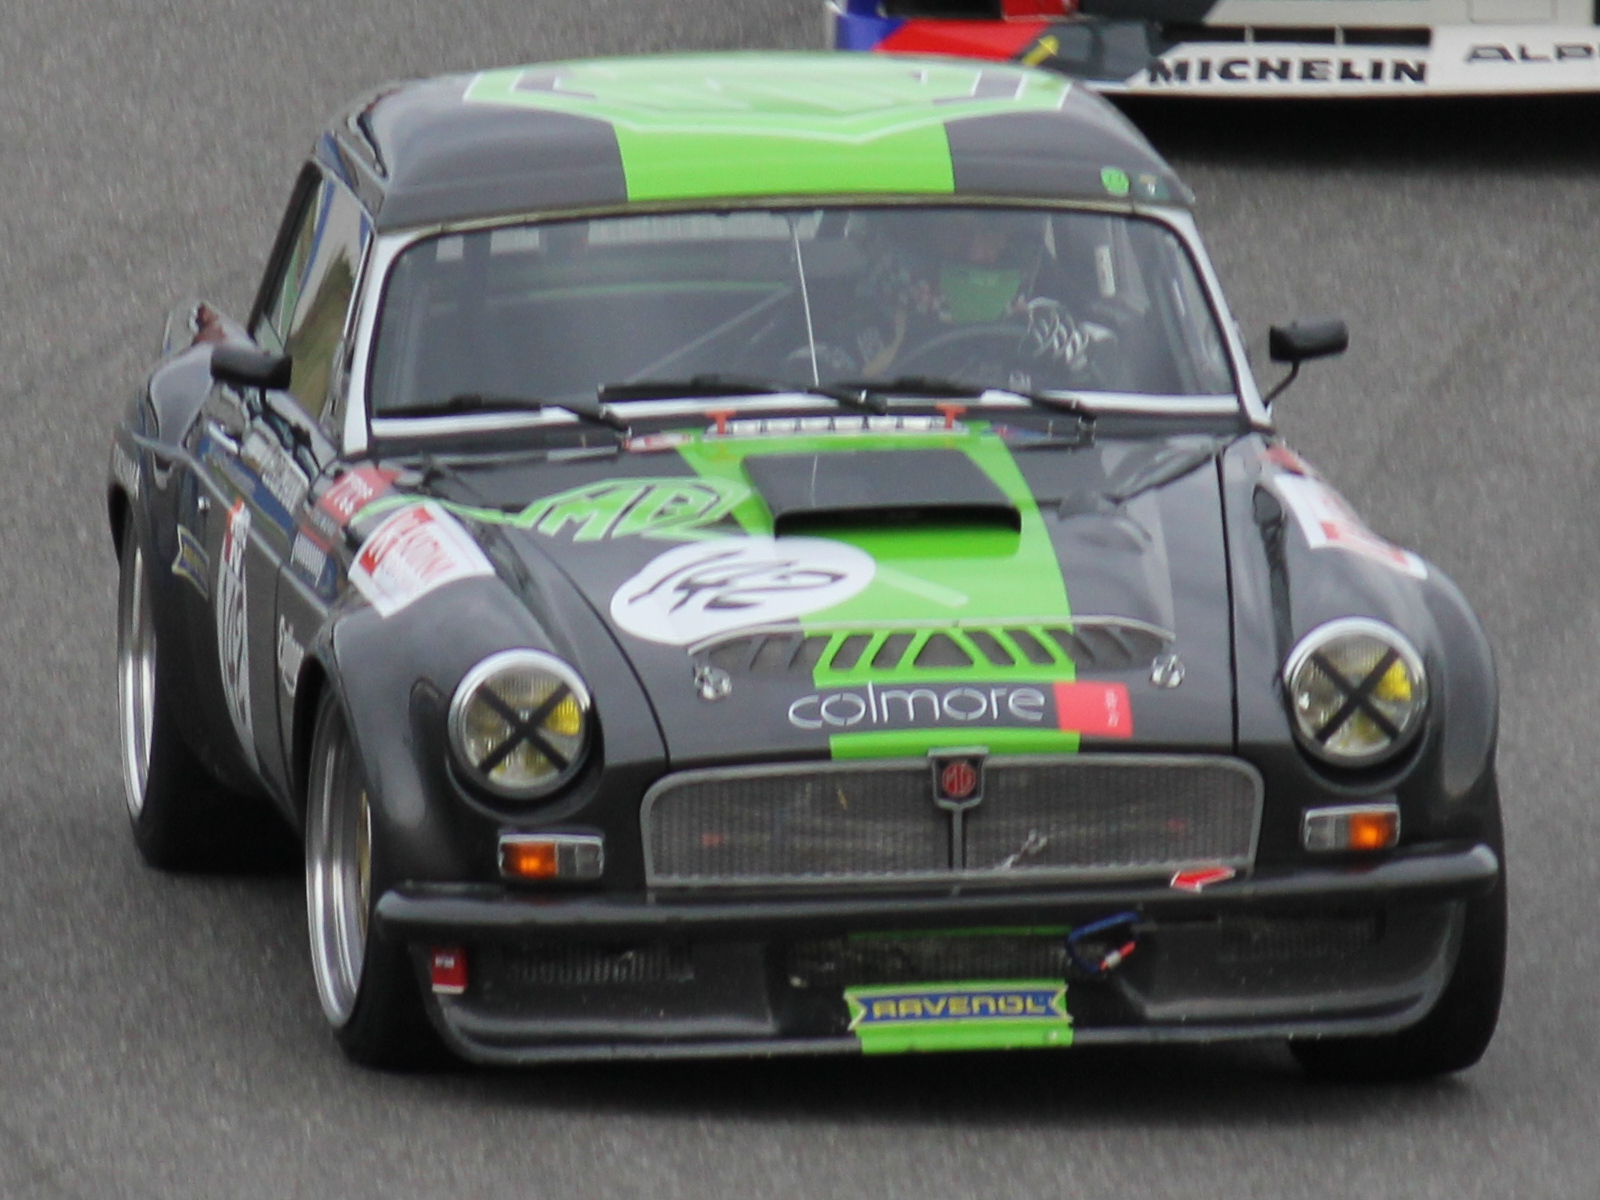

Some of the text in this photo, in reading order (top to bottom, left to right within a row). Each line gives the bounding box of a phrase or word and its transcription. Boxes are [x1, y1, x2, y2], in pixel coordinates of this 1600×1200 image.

[1466, 43, 1600, 62] ALP
[1148, 57, 1428, 83] MICHELIN
[788, 680, 1046, 729] colmore
[872, 995, 1046, 1019] RAVENOL
